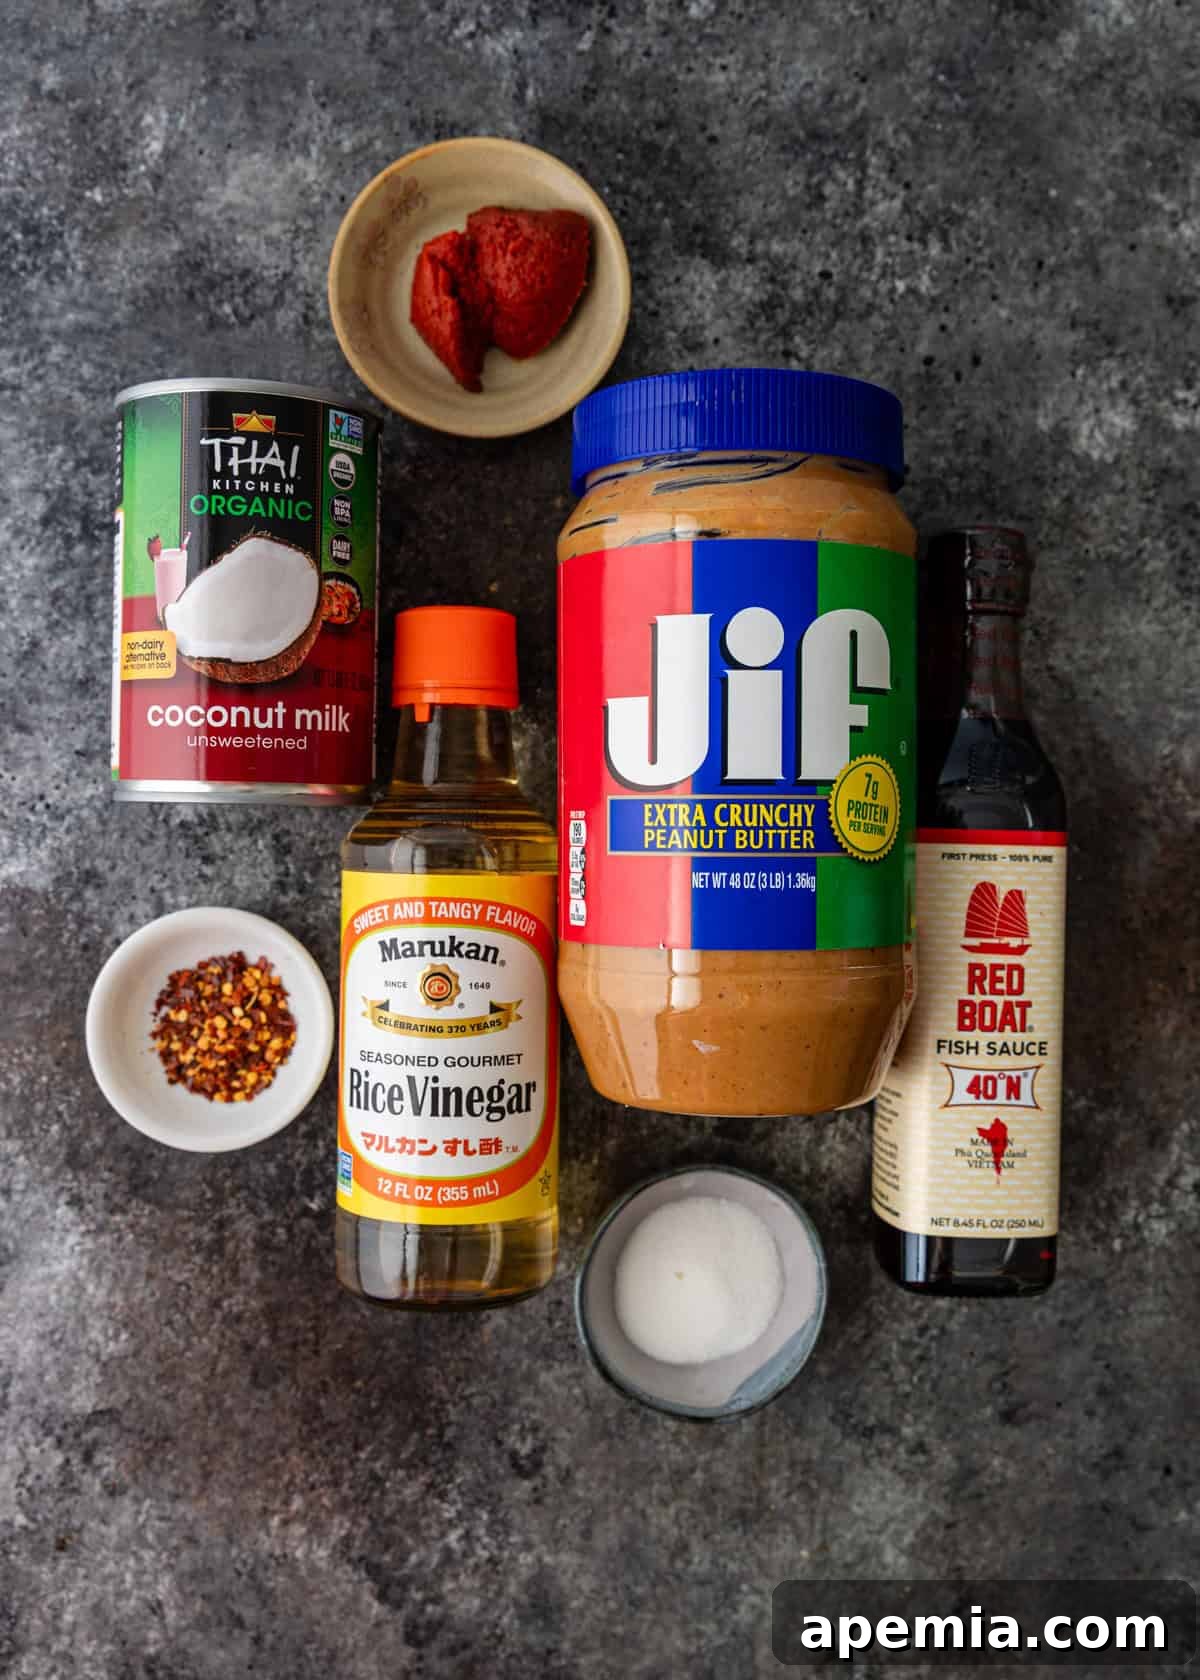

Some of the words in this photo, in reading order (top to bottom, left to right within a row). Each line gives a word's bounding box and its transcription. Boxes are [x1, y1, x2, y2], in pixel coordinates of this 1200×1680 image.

[200, 436, 299, 480] THAI
[212, 479, 295, 494] KITCHEN
[190, 494, 312, 521] ORGANIC
[127, 639, 165, 650] non-dairy
[603, 607, 892, 792] Jif
[146, 701, 286, 729] coconut
[295, 704, 351, 733] milk
[186, 735, 307, 751] unsweetened
[864, 772, 879, 800] 7g
[643, 803, 707, 827] EXTRA
[714, 803, 816, 827] CRUNCHY
[847, 799, 889, 824] PROTEIN
[643, 829, 725, 849] PEANUT
[734, 829, 816, 850] BUTTER
[941, 852, 967, 861] FIRST
[969, 853, 998, 862] PRESS
[1032, 855, 1054, 863] PURE
[692, 871, 710, 889] NET
[712, 871, 728, 889] WT
[729, 871, 741, 889] 48
[743, 872, 756, 889] OZ
[758, 870, 767, 891] (3
[770, 870, 785, 891] LB)
[786, 872, 816, 892] 1.36kg
[354, 906, 389, 934] SWEET
[393, 901, 425, 920] AND
[429, 901, 483, 921] TANGY
[486, 906, 537, 937] FLAVOR
[378, 935, 500, 965] Marukan
[384, 980, 408, 989] SINCE
[469, 982, 491, 990] 1649
[967, 962, 1025, 996] RED
[377, 1015, 444, 1034] CELEBRATING
[447, 1025, 466, 1034] 370
[469, 1018, 502, 1032] YEARS
[957, 999, 1032, 1033] BOAT
[360, 1050, 439, 1067] SEASONED
[443, 1053, 523, 1068] GOURMET
[936, 1039, 979, 1056] FISH
[986, 1041, 1049, 1057] SAUCE
[360, 1131, 438, 1157] マルカン
[442, 1137, 503, 1157] すし酢
[376, 1177, 391, 1193] 12
[395, 1182, 411, 1199] FL
[415, 1185, 433, 1201] OZ
[437, 1185, 469, 1204] (355
[473, 1179, 500, 1199] mL)
[931, 1217, 950, 1227] NET
[976, 1219, 986, 1228] FL
[990, 1219, 1005, 1228] OZ
